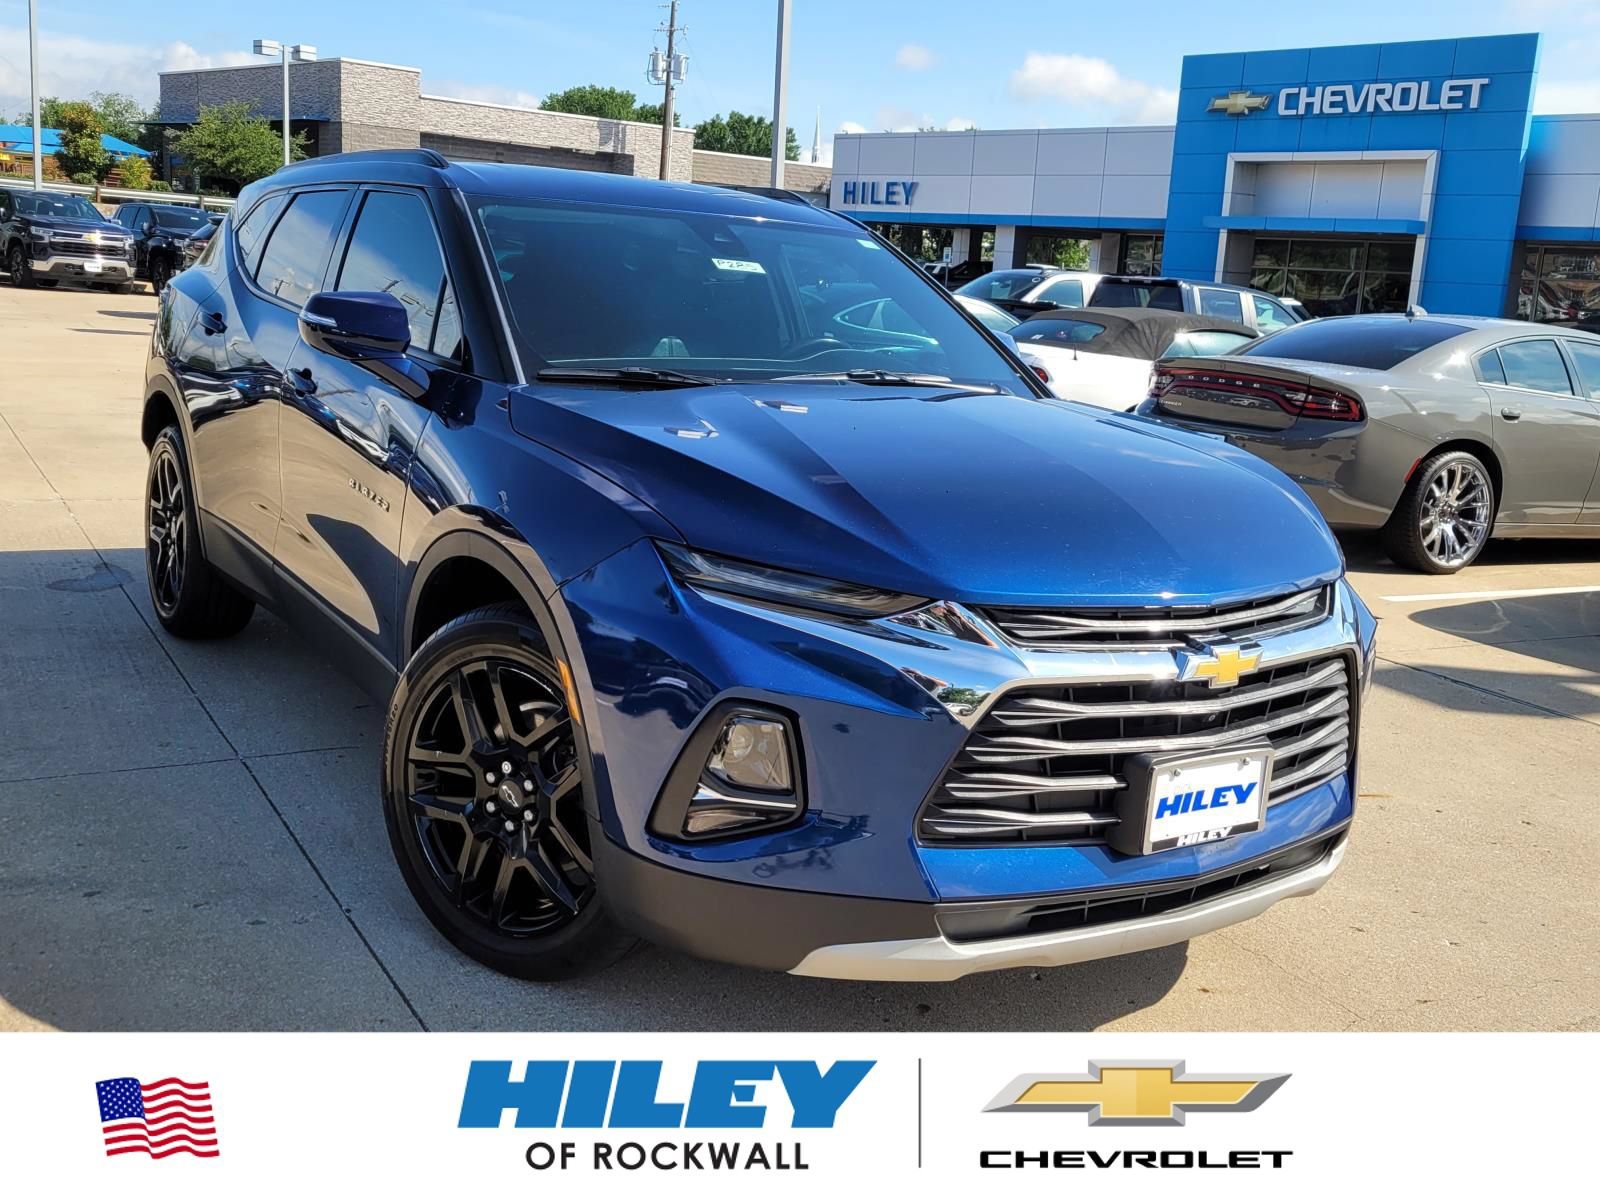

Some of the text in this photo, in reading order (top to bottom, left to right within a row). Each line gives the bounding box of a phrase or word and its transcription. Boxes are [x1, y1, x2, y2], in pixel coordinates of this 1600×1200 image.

[1278, 78, 1489, 116] CHEVROLET
[843, 181, 918, 205] HILEY
[349, 478, 390, 512] BLAZER
[1155, 782, 1258, 819] HILEY
[1176, 826, 1233, 847] HILEY
